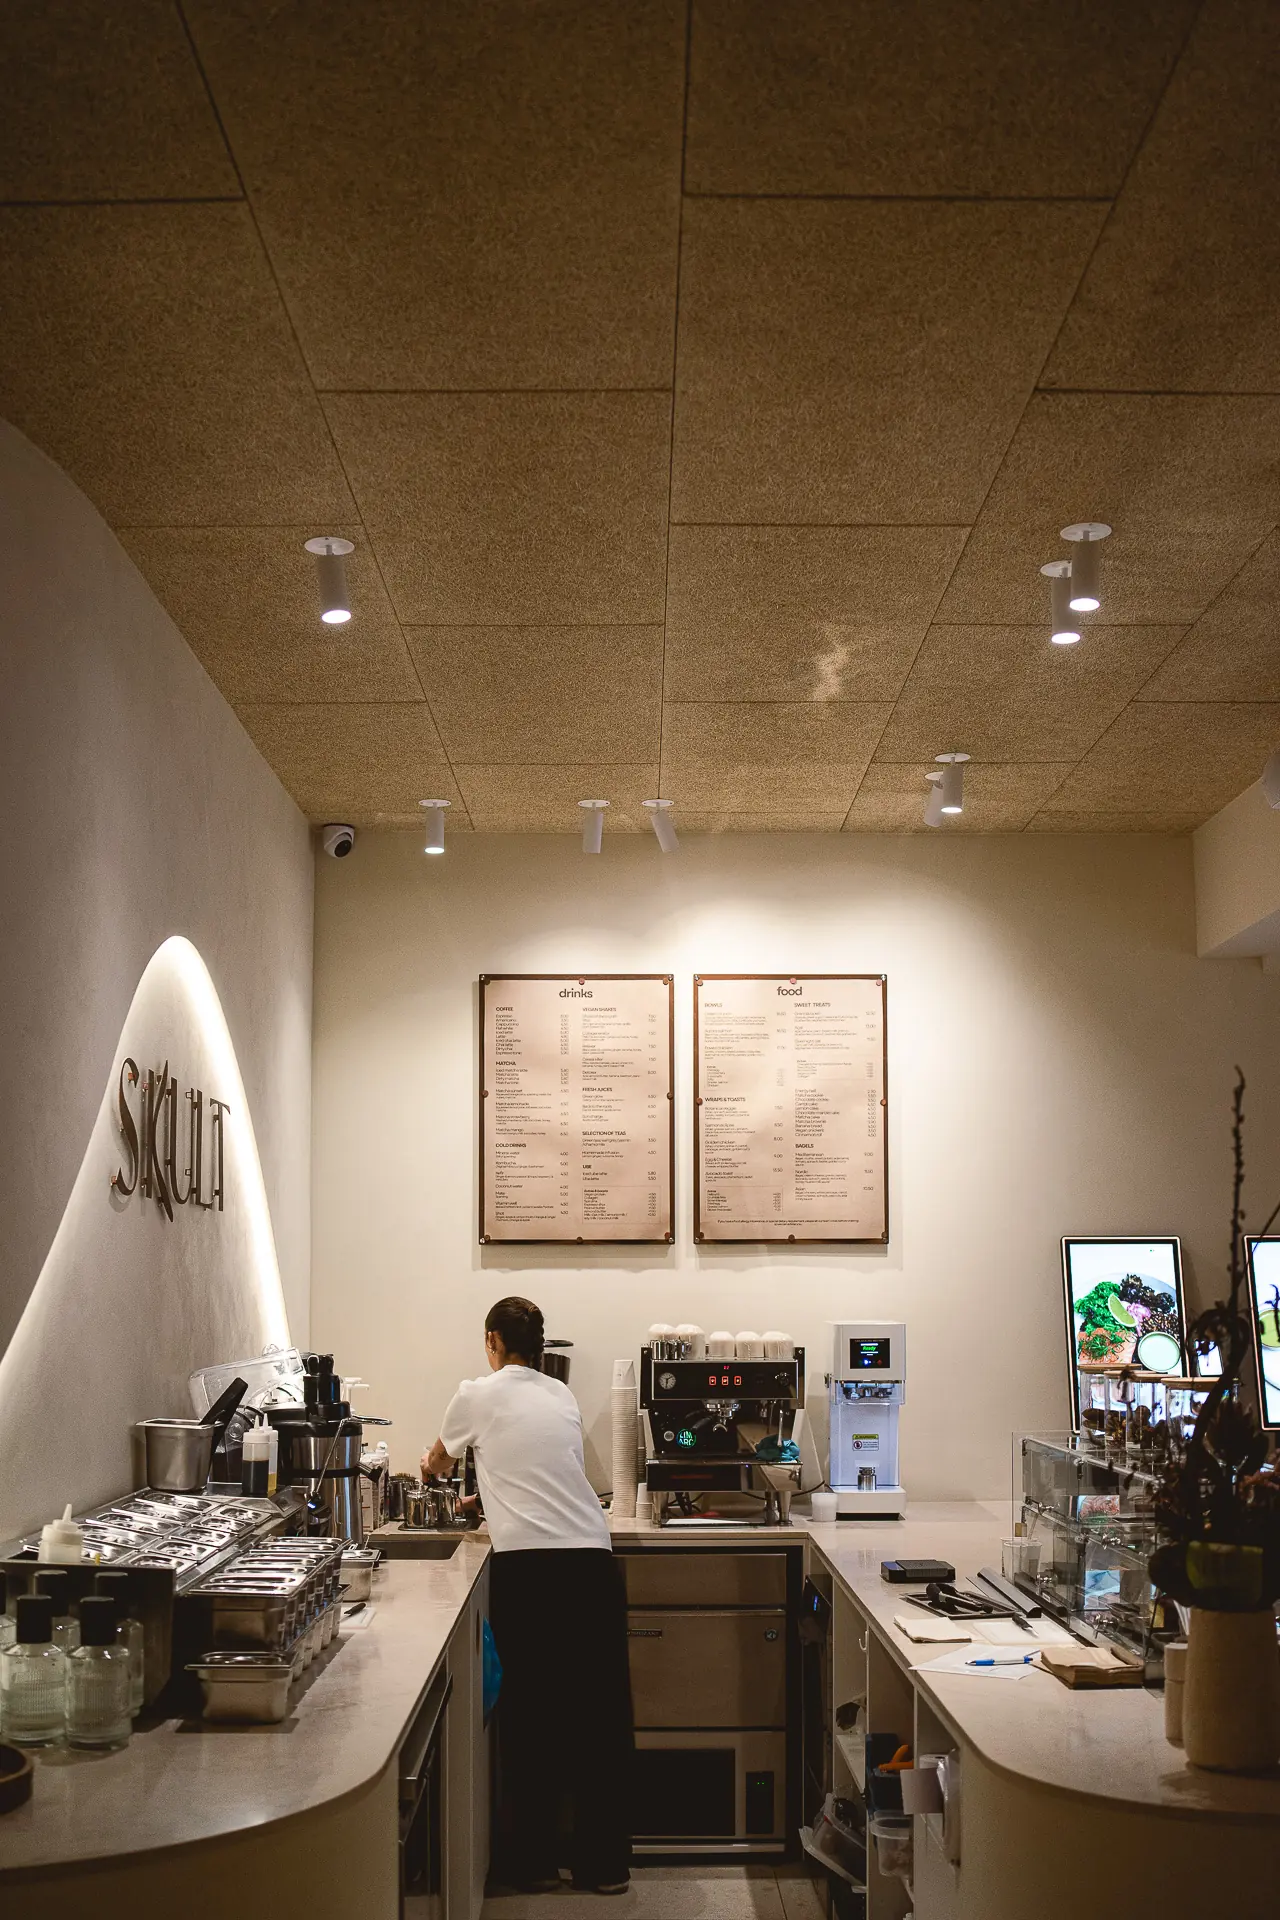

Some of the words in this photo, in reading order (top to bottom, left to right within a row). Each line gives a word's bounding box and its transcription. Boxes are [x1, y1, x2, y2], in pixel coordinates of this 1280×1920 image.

[559, 988, 593, 998] drinks
[777, 986, 802, 996] food
[116, 1057, 231, 1222] SKULT
